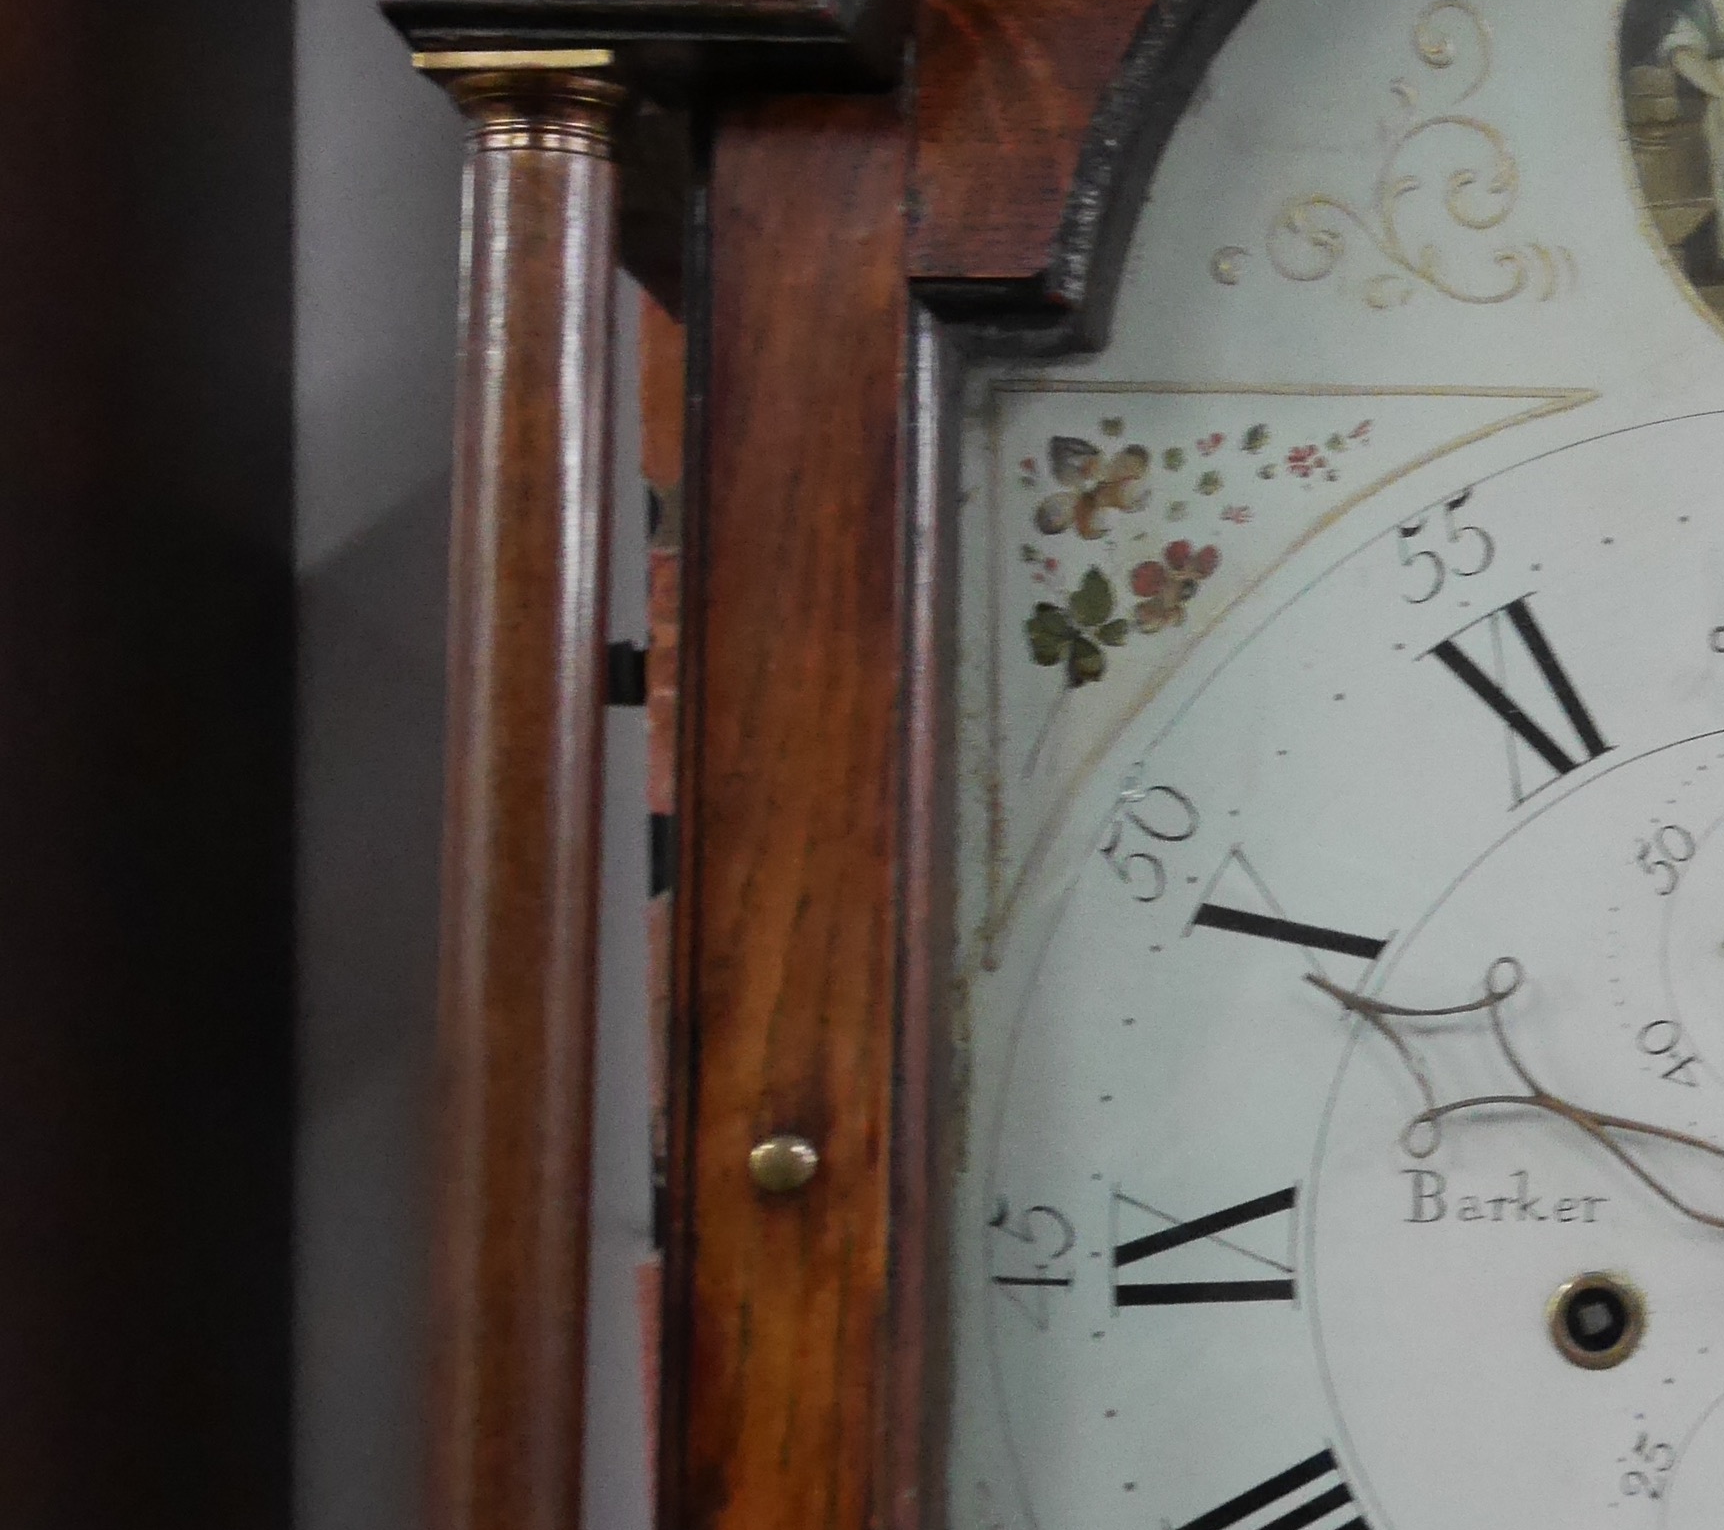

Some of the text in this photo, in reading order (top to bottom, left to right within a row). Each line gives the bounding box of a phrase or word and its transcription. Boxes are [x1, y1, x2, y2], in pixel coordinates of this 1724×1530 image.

[1398, 488, 1494, 604] 55
[1412, 591, 1619, 811] XI
[1100, 785, 1198, 902] 50
[1637, 825, 1696, 895] 50
[1180, 842, 1398, 1021] X
[1636, 1019, 1701, 1087] 40
[1108, 1179, 1303, 1316] IX
[1399, 1169, 1610, 1223] Barker
[988, 1195, 1076, 1330] 45
[1620, 1433, 1676, 1499] 25
